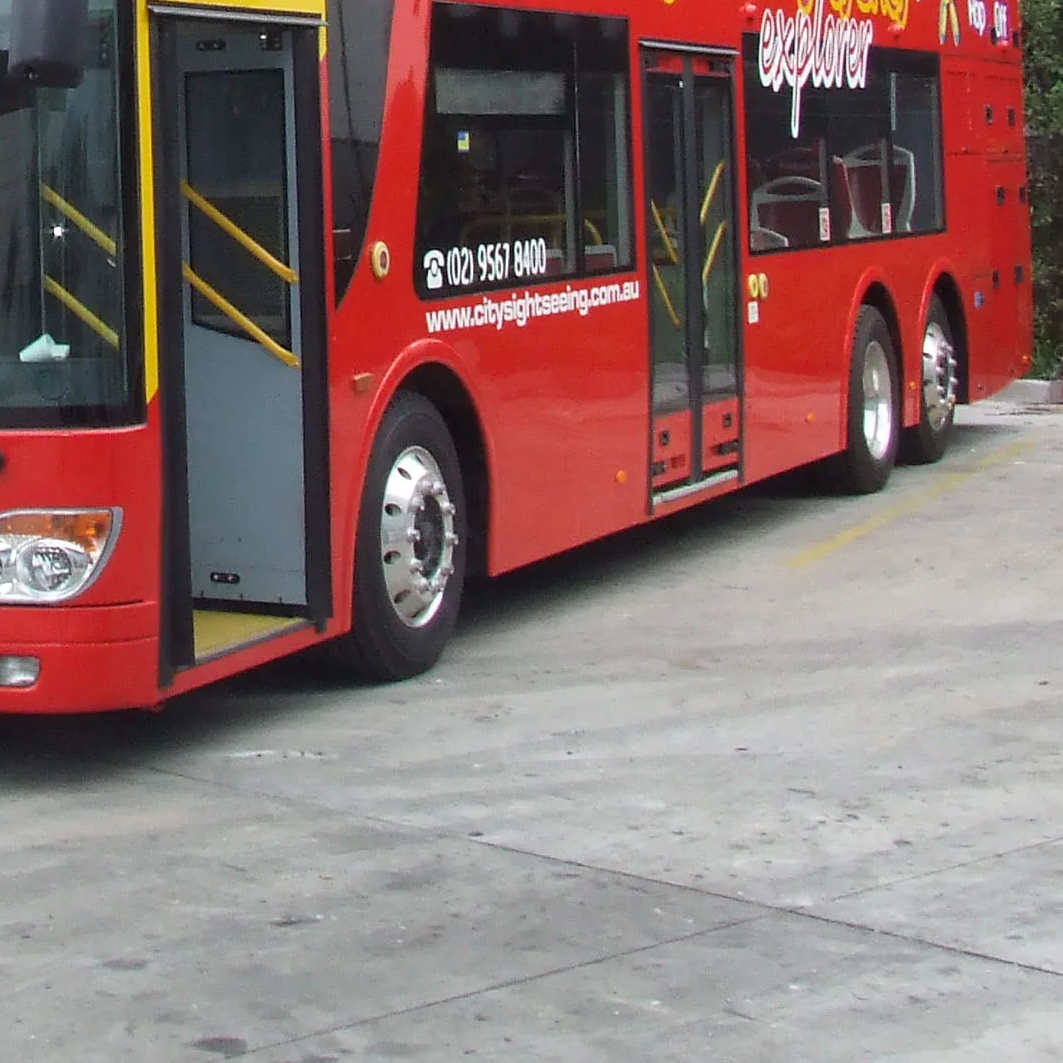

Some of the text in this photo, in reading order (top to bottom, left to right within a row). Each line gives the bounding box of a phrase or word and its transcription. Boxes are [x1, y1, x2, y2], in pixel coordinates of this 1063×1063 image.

[446, 237, 547, 286] (02) 9567 8400
[425, 280, 640, 333] www.citysightseeing.com.au
